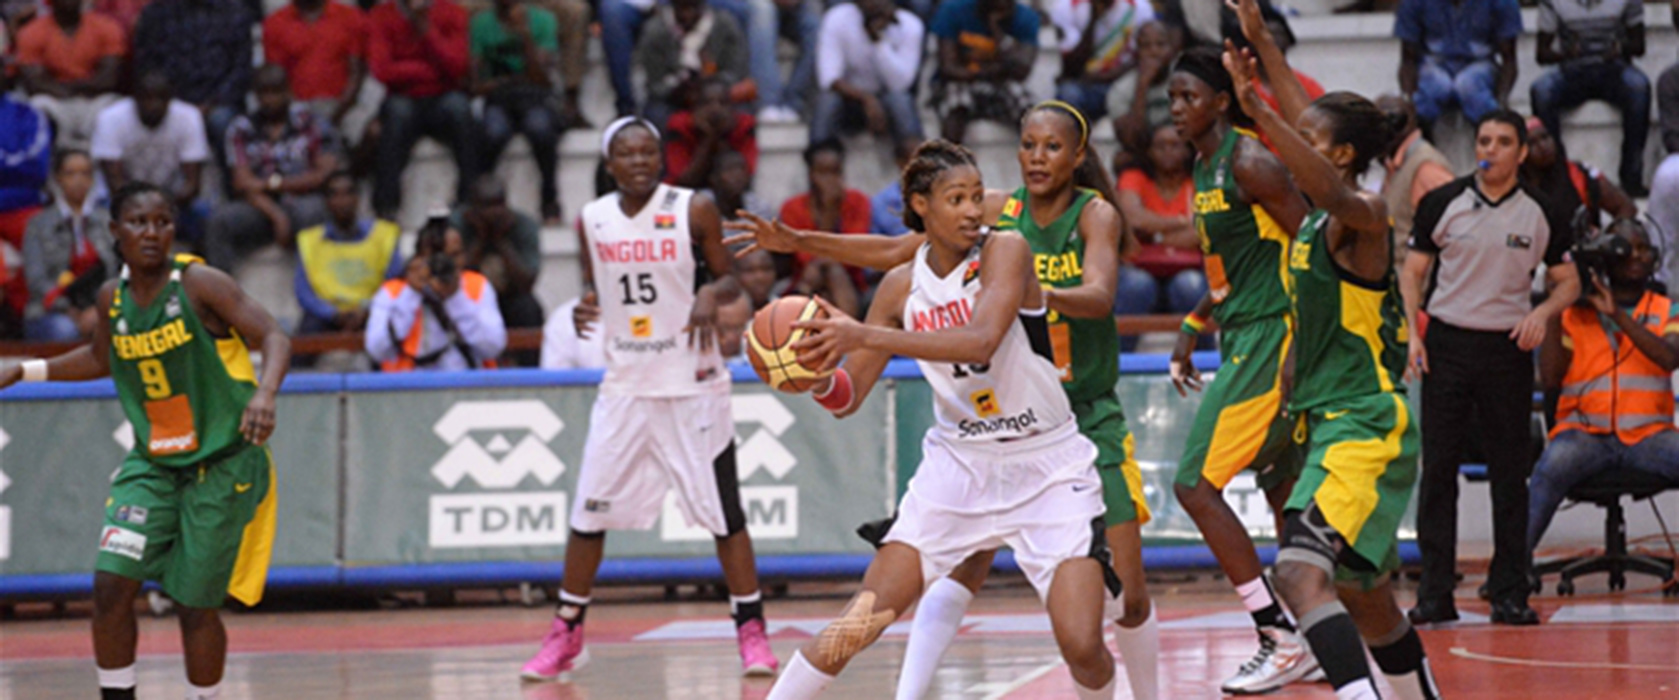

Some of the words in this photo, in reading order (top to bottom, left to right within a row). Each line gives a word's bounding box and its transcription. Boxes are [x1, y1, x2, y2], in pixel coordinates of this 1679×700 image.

[1034, 251, 1083, 281] EGAL
[619, 272, 657, 305] 15
[113, 319, 192, 359] SENEGAL
[137, 358, 172, 399] 9
[958, 409, 1037, 437] Sonangol
[443, 504, 556, 534] TDM
